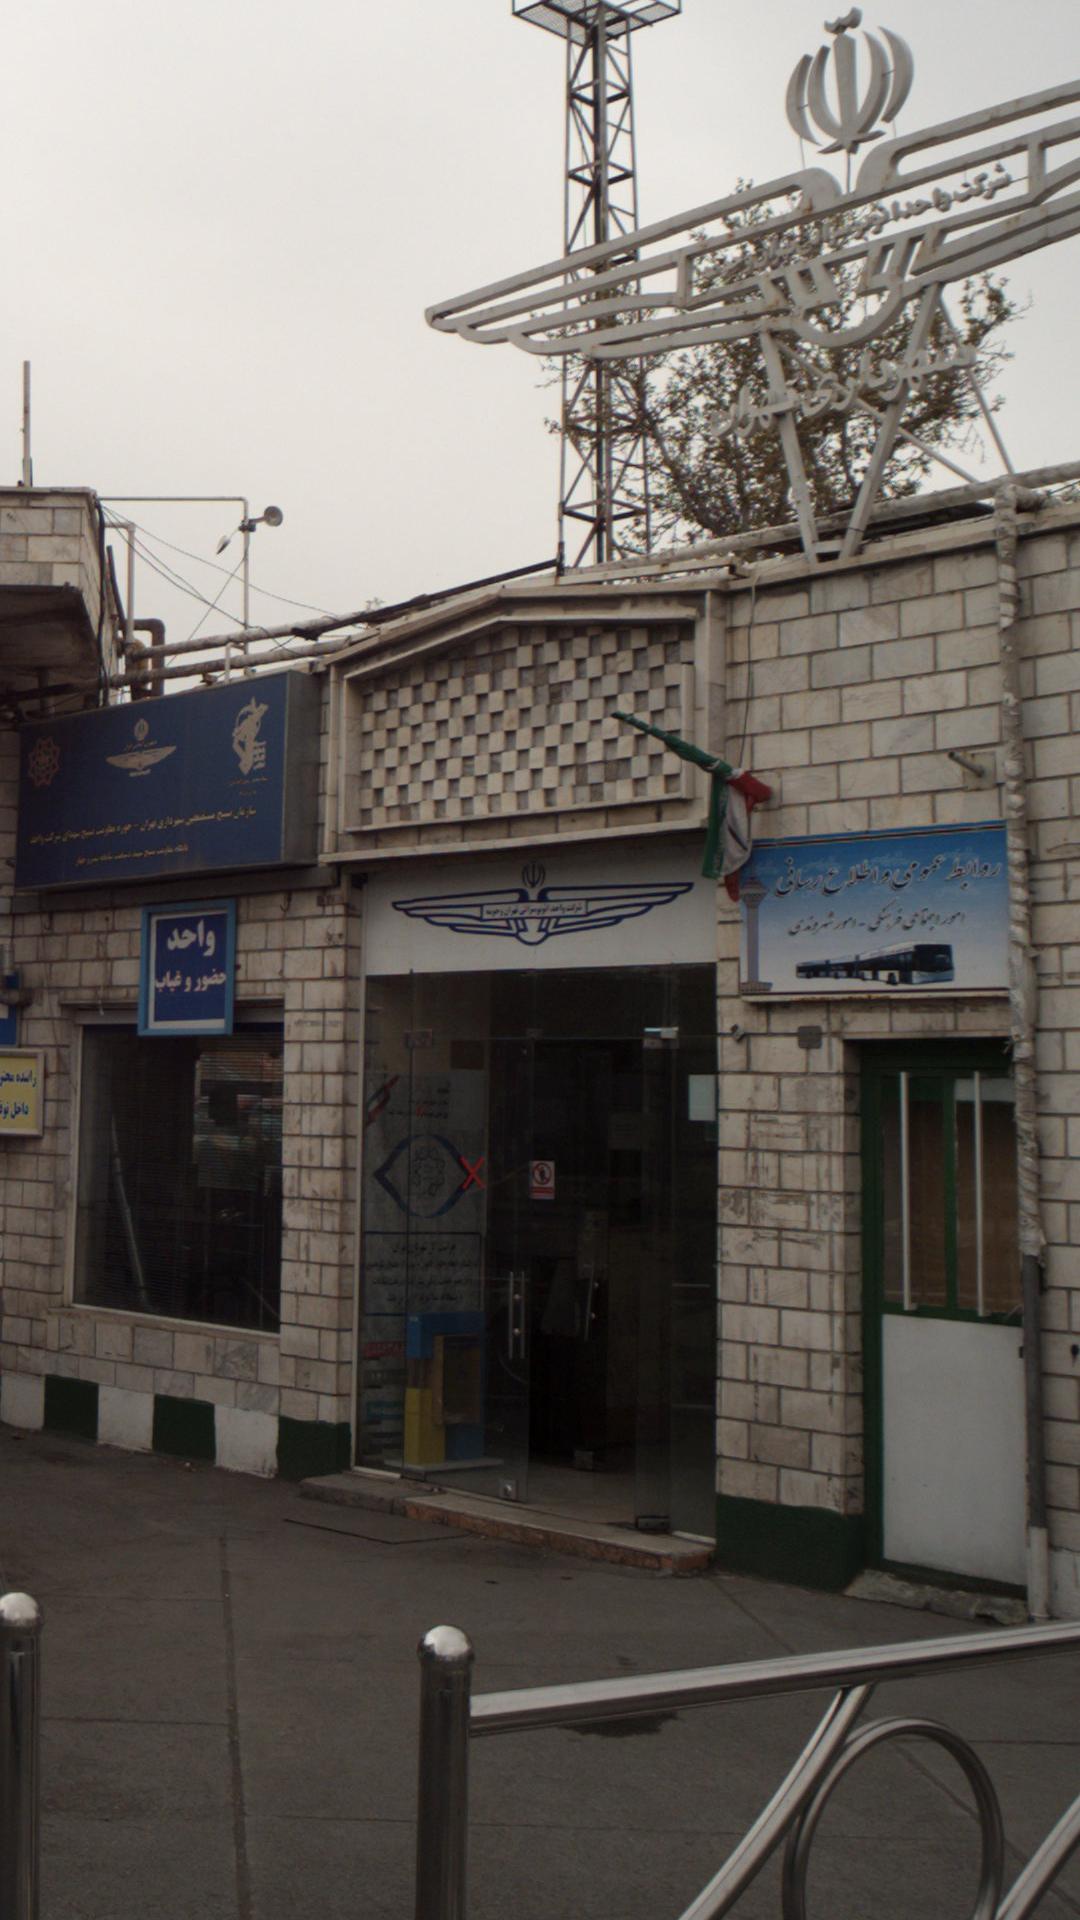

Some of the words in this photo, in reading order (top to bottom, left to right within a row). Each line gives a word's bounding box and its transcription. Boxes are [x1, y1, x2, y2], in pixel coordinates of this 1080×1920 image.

[951, 163, 1012, 201] شرکت
[904, 187, 951, 219] واحد
[800, 344, 977, 418] شهرداری
[711, 383, 800, 437] تهران
[775, 857, 822, 897] رسانی
[822, 859, 879, 896] اطلاع
[880, 869, 891, 883] و
[891, 854, 945, 890] عمومی
[944, 856, 1003, 890] روابط
[788, 911, 834, 936] شهروندی
[834, 916, 857, 930] امور
[868, 896, 903, 932] فرهنگی
[902, 907, 940, 932] اجتماعی
[941, 911, 966, 927] امور
[167, 920, 216, 957] واحد
[155, 970, 182, 992] غیاب
[184, 976, 192, 992] و
[193, 968, 227, 992] حضور
